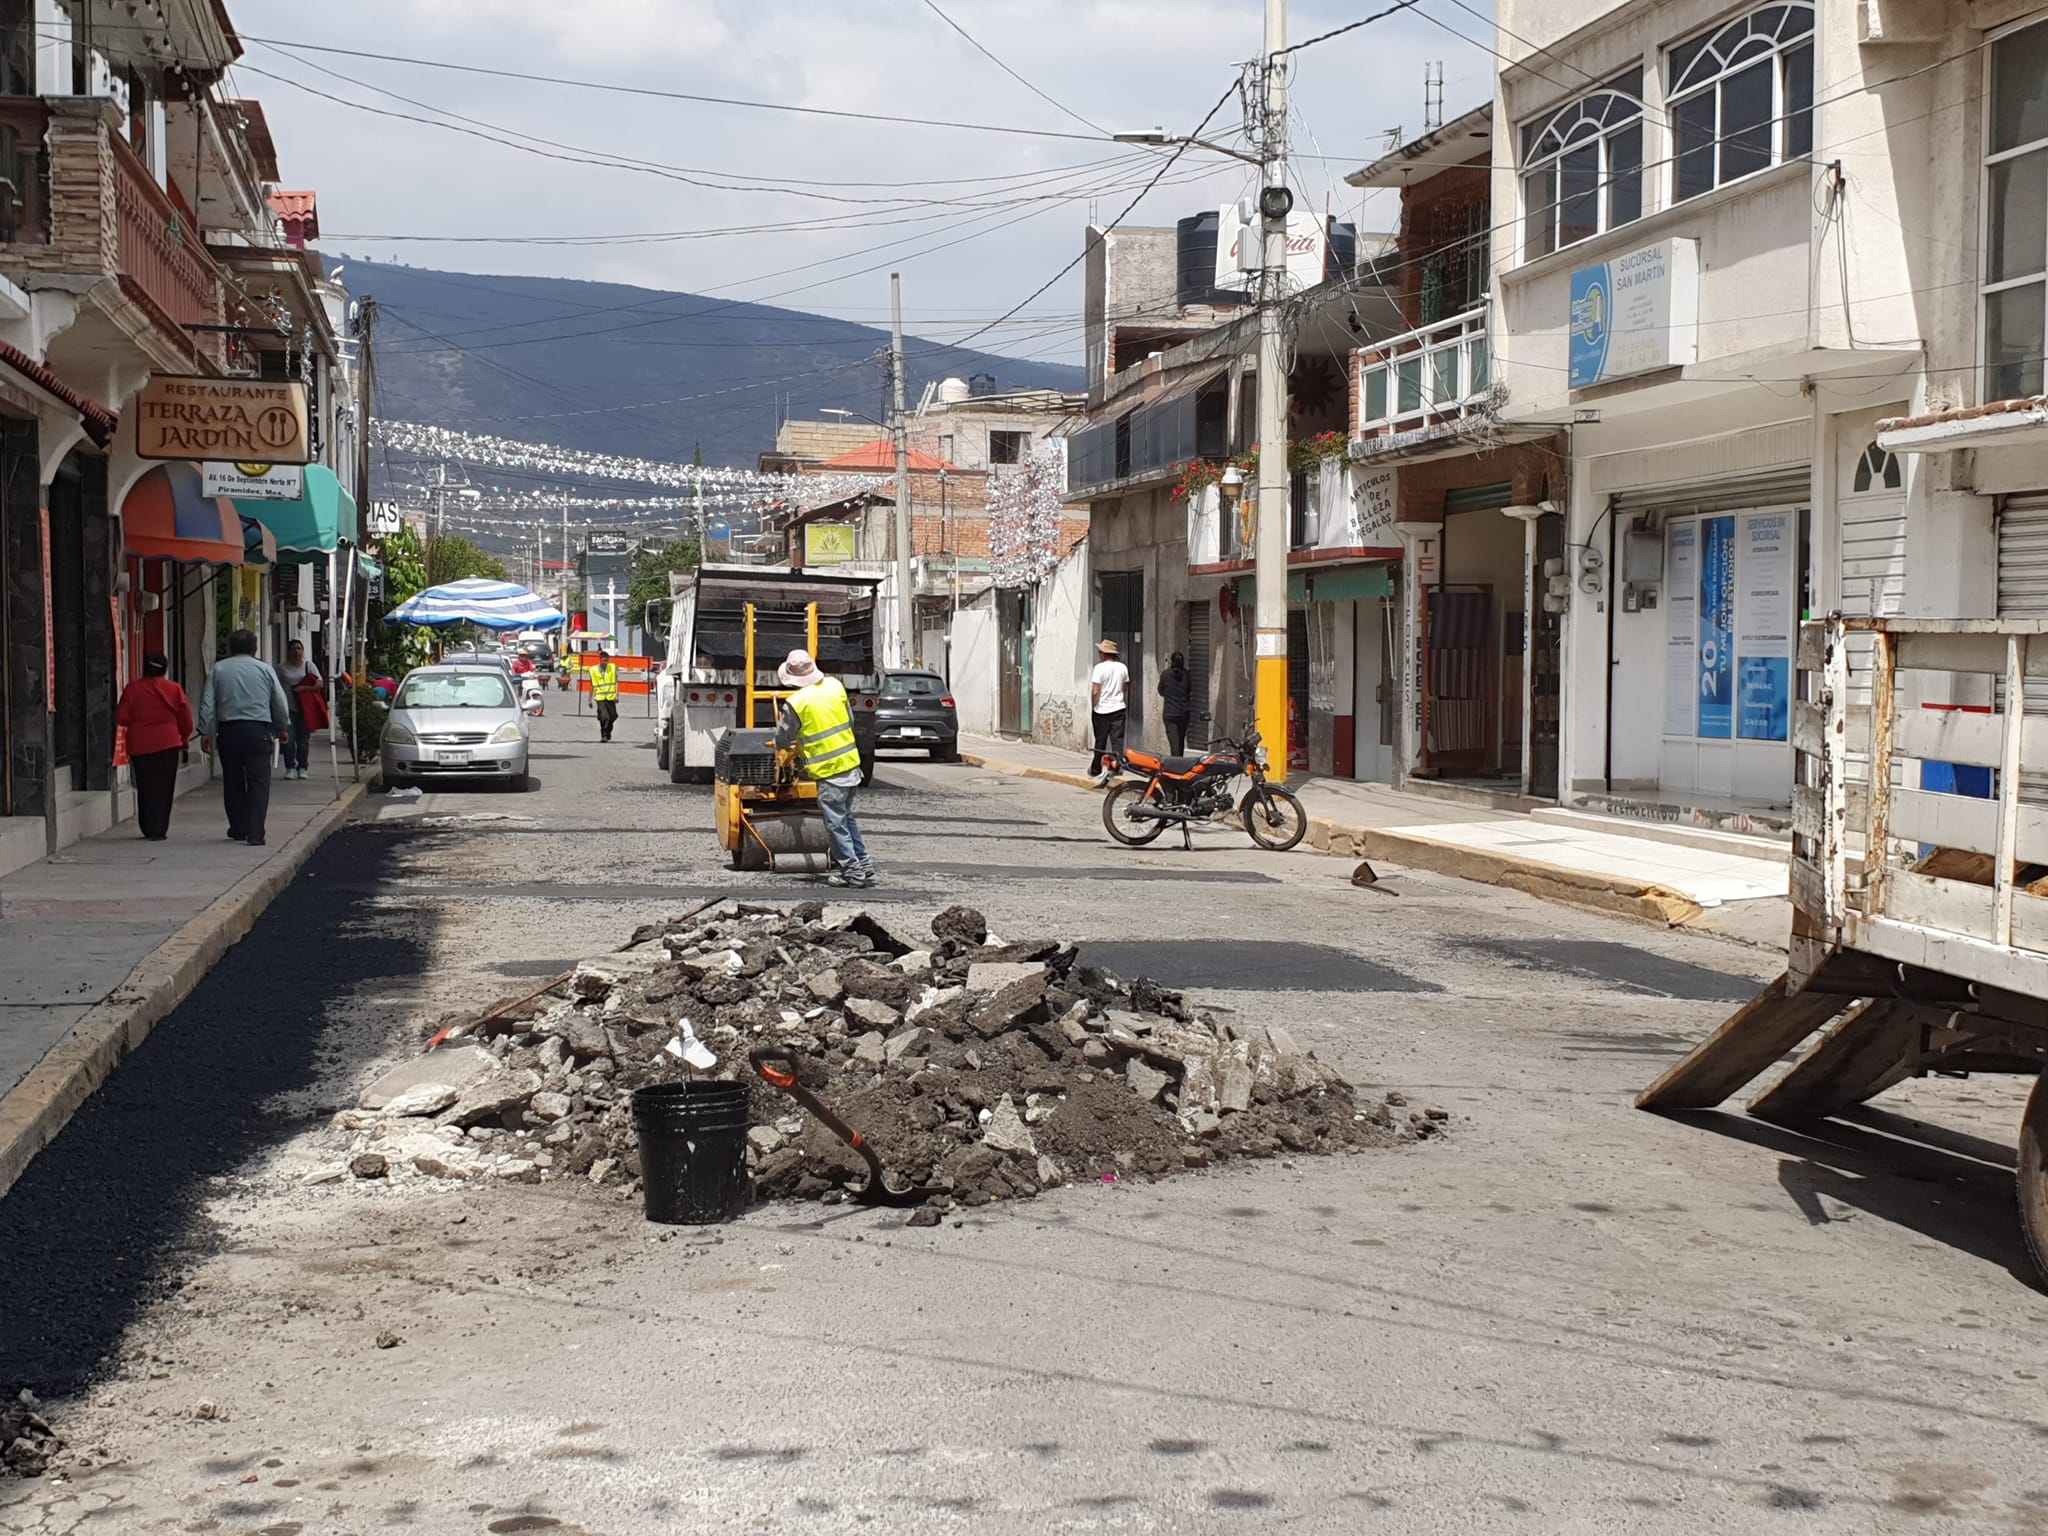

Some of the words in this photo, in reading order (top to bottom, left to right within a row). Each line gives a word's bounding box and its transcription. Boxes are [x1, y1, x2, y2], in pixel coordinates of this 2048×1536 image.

[1616, 274, 1633, 292] SAN
[165, 383, 288, 400] RESTAURANTE
[142, 402, 254, 427] TERRAZA
[159, 425, 258, 451] JARDÍN
[1350, 473, 1392, 505] ARTICULOS
[1369, 491, 1382, 501] DE
[1350, 499, 1392, 528] BELLEZA
[1356, 512, 1393, 541] REGALOS
[1727, 537, 1735, 610] ESTUDIOS
[1403, 562, 1412, 702] UNIFORMES
[1719, 602, 1728, 653] MEJOR
[1727, 614, 1734, 633] EN
[1701, 640, 1718, 697] 20
[1719, 654, 1727, 674] TU
